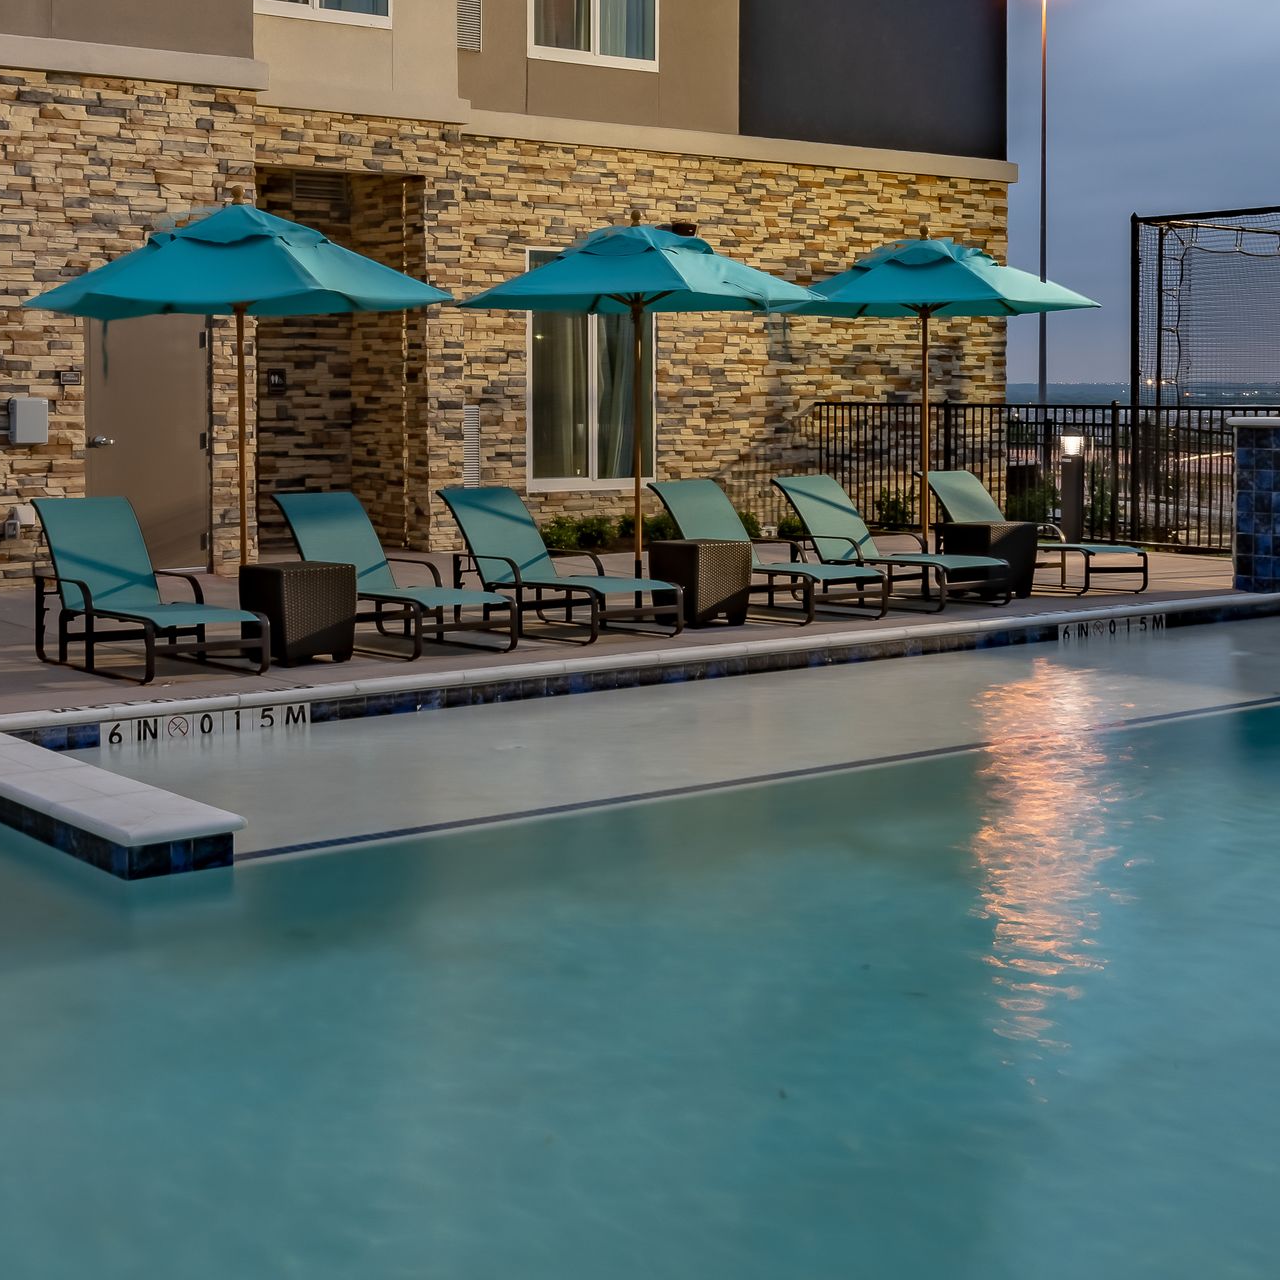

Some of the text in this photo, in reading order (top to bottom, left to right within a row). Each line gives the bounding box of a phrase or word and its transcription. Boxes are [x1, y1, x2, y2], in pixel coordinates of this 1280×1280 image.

[1077, 622, 1089, 638] IN
[108, 722, 122, 744] 6
[137, 718, 158, 741] IN
[260, 707, 274, 728] 5
[285, 704, 306, 725] M
